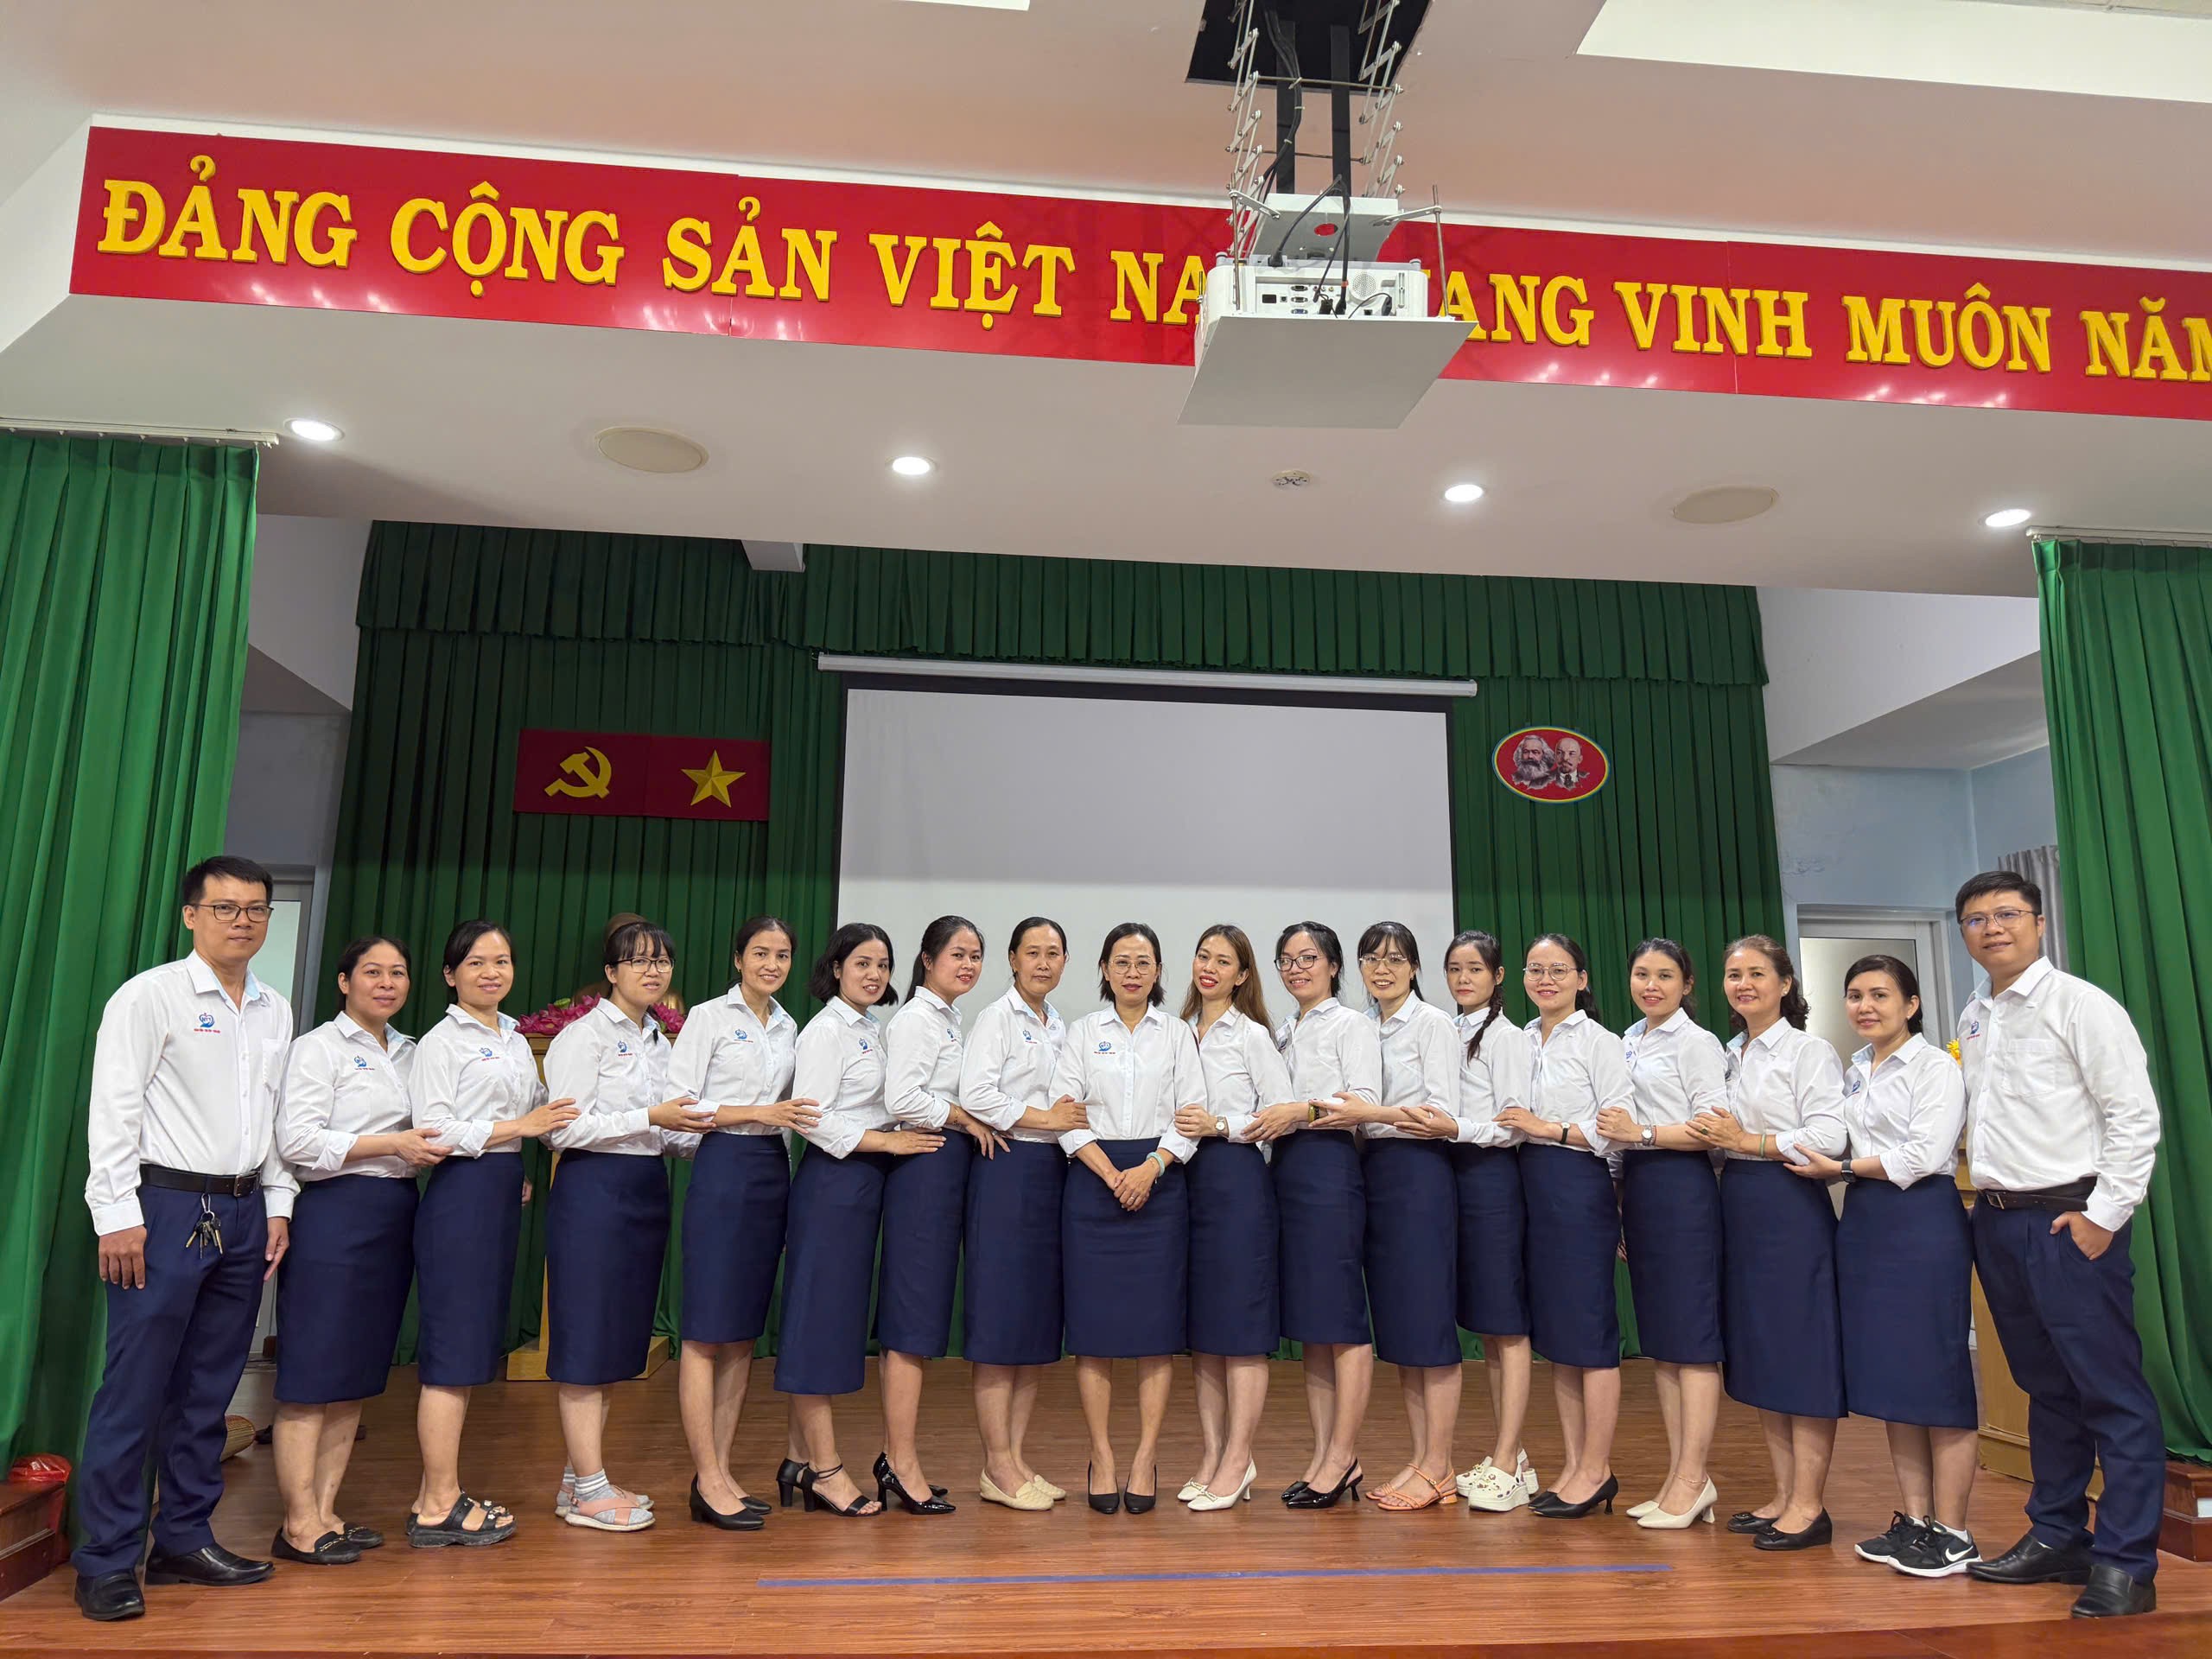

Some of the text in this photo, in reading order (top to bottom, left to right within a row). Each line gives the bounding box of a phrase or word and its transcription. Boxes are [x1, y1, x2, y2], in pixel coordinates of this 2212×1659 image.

[99, 156, 356, 266] ĐẢNG
[391, 181, 623, 296] CỘNG
[663, 196, 837, 301] SẢN
[869, 221, 1075, 329] VIỆT
[1110, 251, 1207, 325] NA
[1421, 270, 1594, 346] ANG
[1614, 282, 1812, 358] VINH
[1843, 283, 2051, 372] MUÔN
